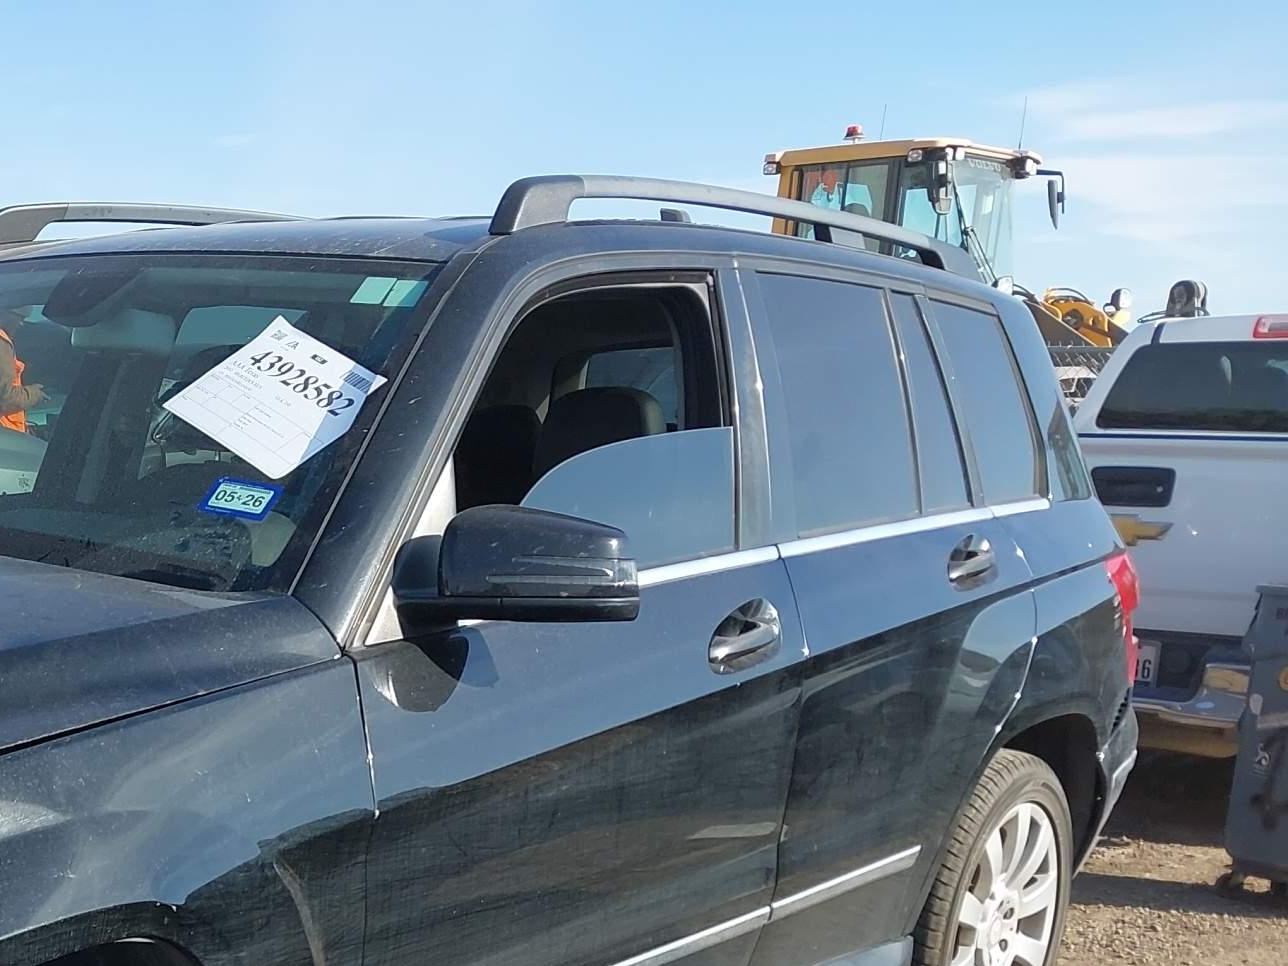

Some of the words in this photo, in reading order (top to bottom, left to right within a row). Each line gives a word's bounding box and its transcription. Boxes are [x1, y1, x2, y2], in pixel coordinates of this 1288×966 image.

[249, 350, 354, 416] 43928582
[214, 489, 238, 503] 05
[240, 494, 265, 507] 26
